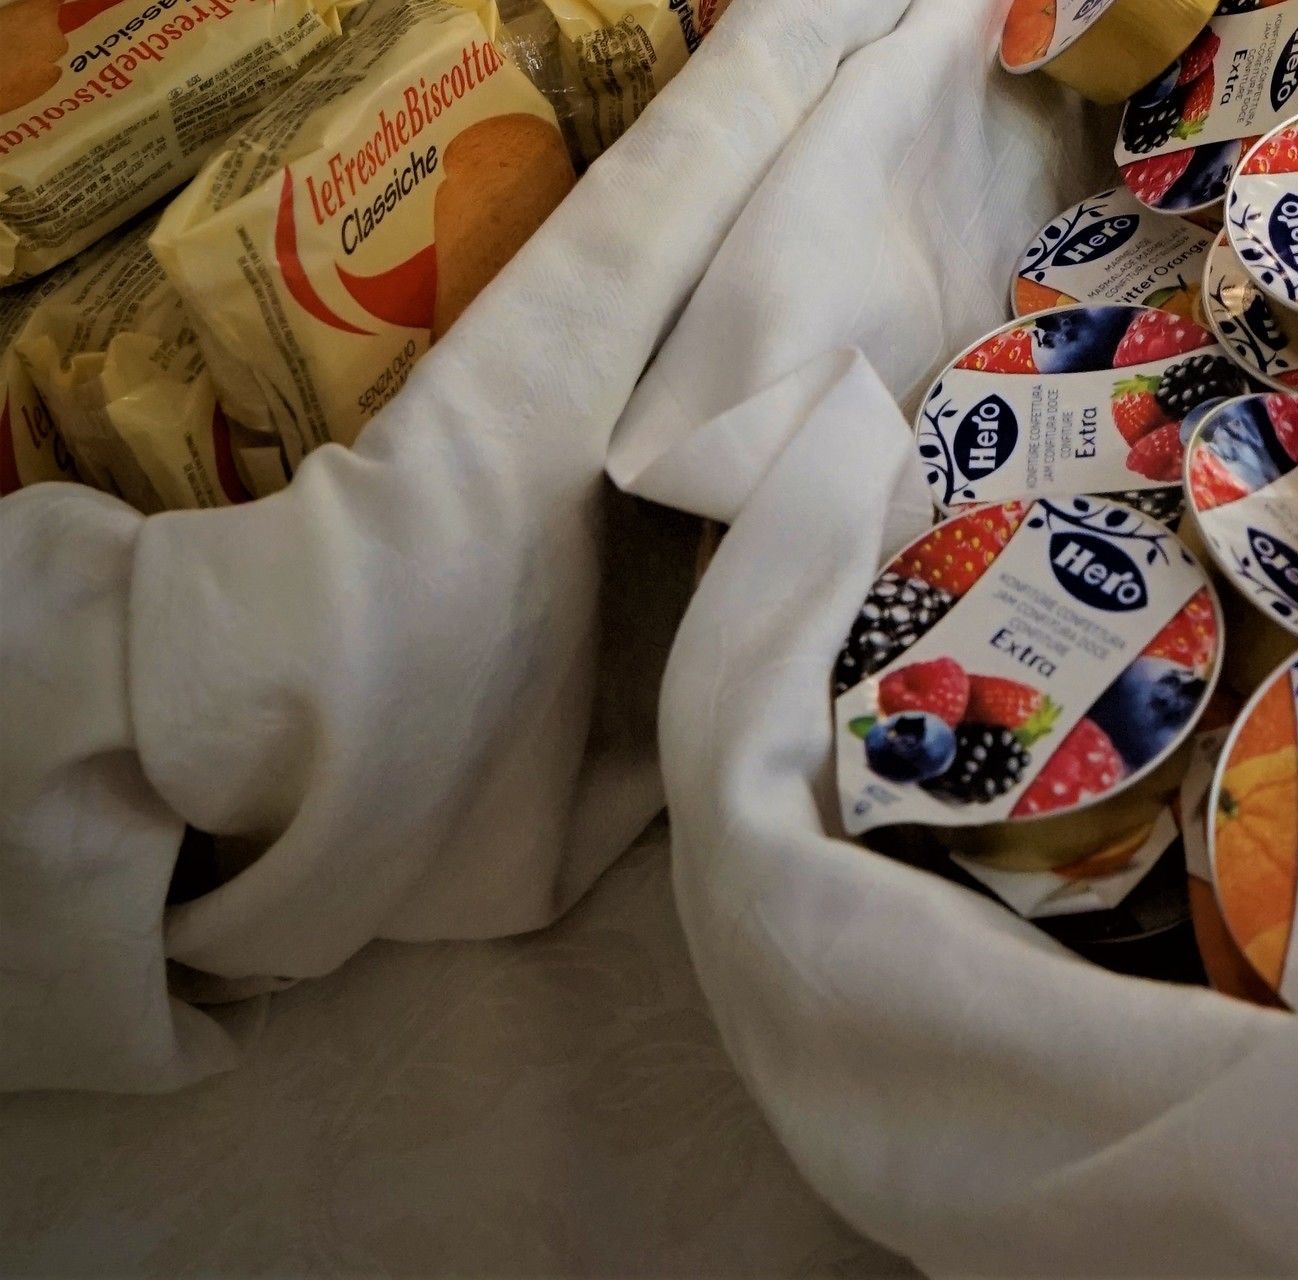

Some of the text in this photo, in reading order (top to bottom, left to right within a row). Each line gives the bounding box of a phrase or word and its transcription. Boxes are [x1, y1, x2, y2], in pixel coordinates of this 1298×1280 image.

[1220, 49, 1248, 106] Extra
[341, 144, 439, 256] Classiche
[1063, 217, 1132, 263] Hero
[1153, 239, 1209, 277] Orange
[969, 402, 1001, 471] Hero
[1074, 405, 1098, 459] Extra
[1054, 539, 1142, 606] Hero
[989, 627, 1057, 678] Extra
